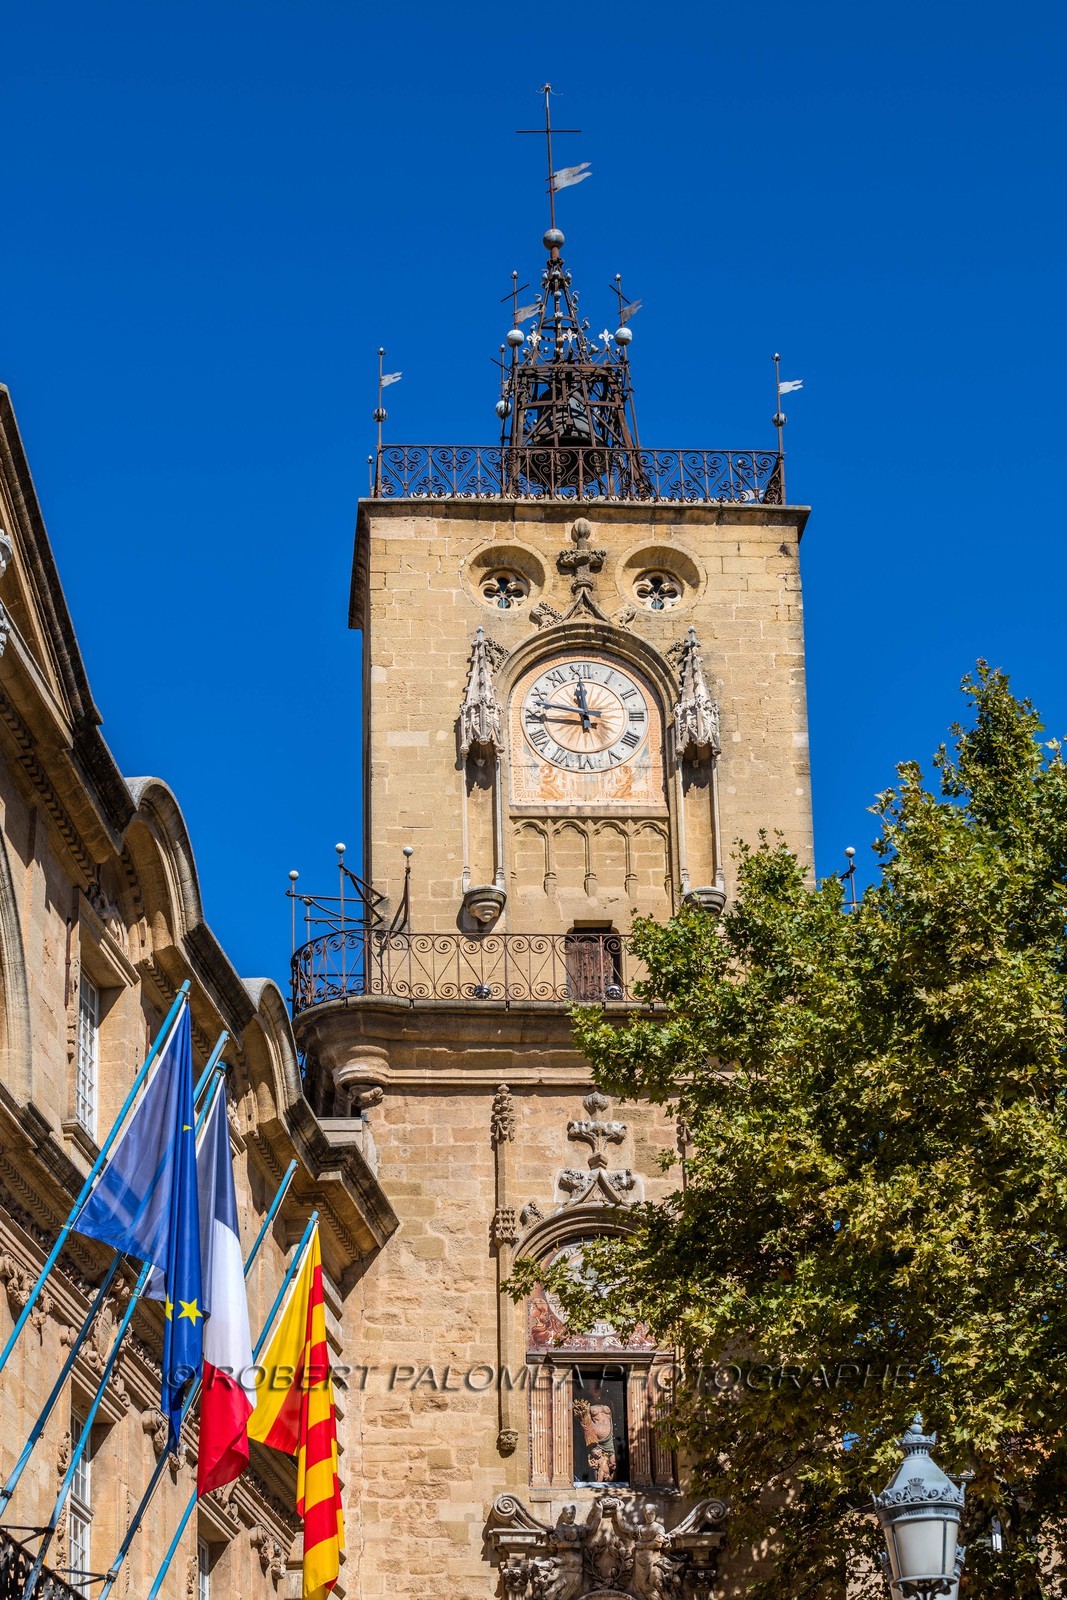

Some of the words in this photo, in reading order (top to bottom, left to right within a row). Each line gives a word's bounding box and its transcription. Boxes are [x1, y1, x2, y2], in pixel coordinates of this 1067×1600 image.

[545, 670, 567, 688] XI
[569, 664, 592, 679] XII
[603, 670, 615, 685] I
[620, 688, 638, 701] II
[628, 712, 645, 722] III
[528, 729, 551, 753] VIII
[620, 731, 641, 749] IIII
[550, 747, 573, 767] VII
[577, 754, 595, 769] VI
[608, 750, 622, 764] V
